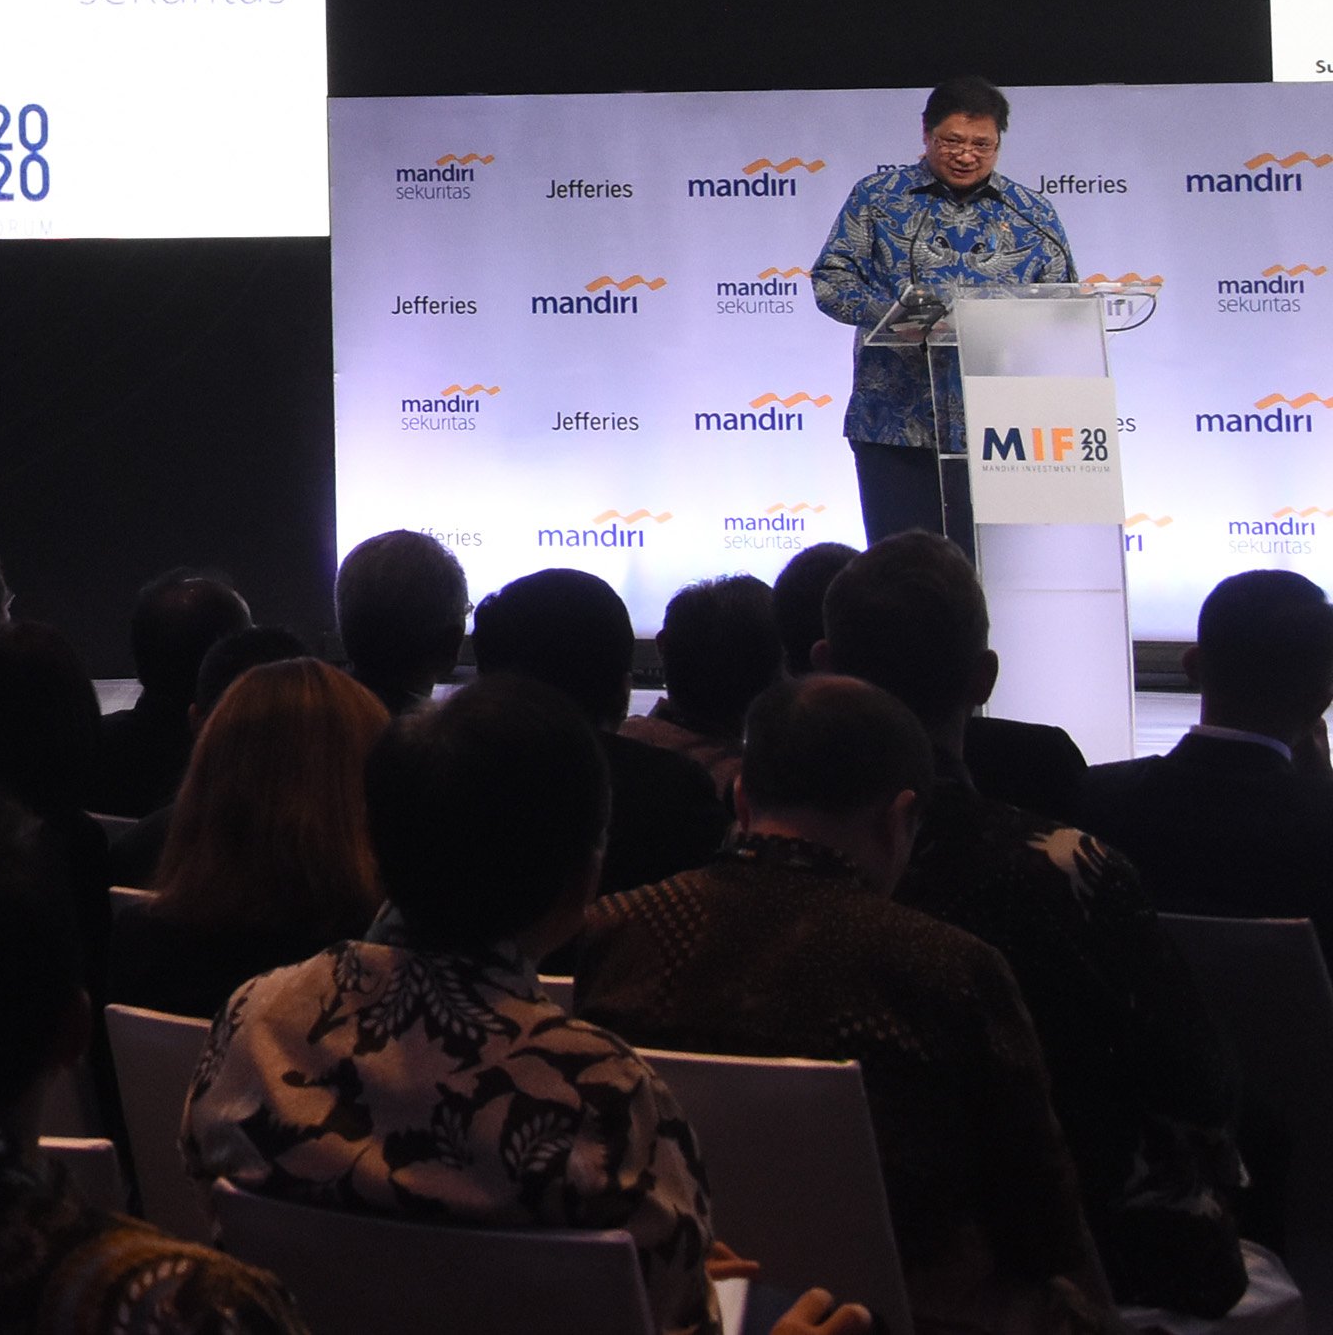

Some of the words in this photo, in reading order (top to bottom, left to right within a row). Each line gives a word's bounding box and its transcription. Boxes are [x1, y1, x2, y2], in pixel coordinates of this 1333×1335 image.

[396, 163, 474, 183] mandiri
[1186, 166, 1302, 193] mandiri
[396, 184, 471, 200] sekuritas
[545, 179, 633, 199] Jefferies
[688, 172, 796, 197] mandiri
[1037, 174, 1129, 195] Jefferies
[717, 277, 798, 297] mandiri
[1218, 274, 1304, 295] mandiri
[391, 295, 478, 315] Jefferies
[531, 289, 638, 315] mandiri
[716, 298, 794, 314] sekuritas
[401, 394, 480, 413] mandiri
[694, 406, 803, 431] mandiri
[1196, 407, 1312, 433] mandiri
